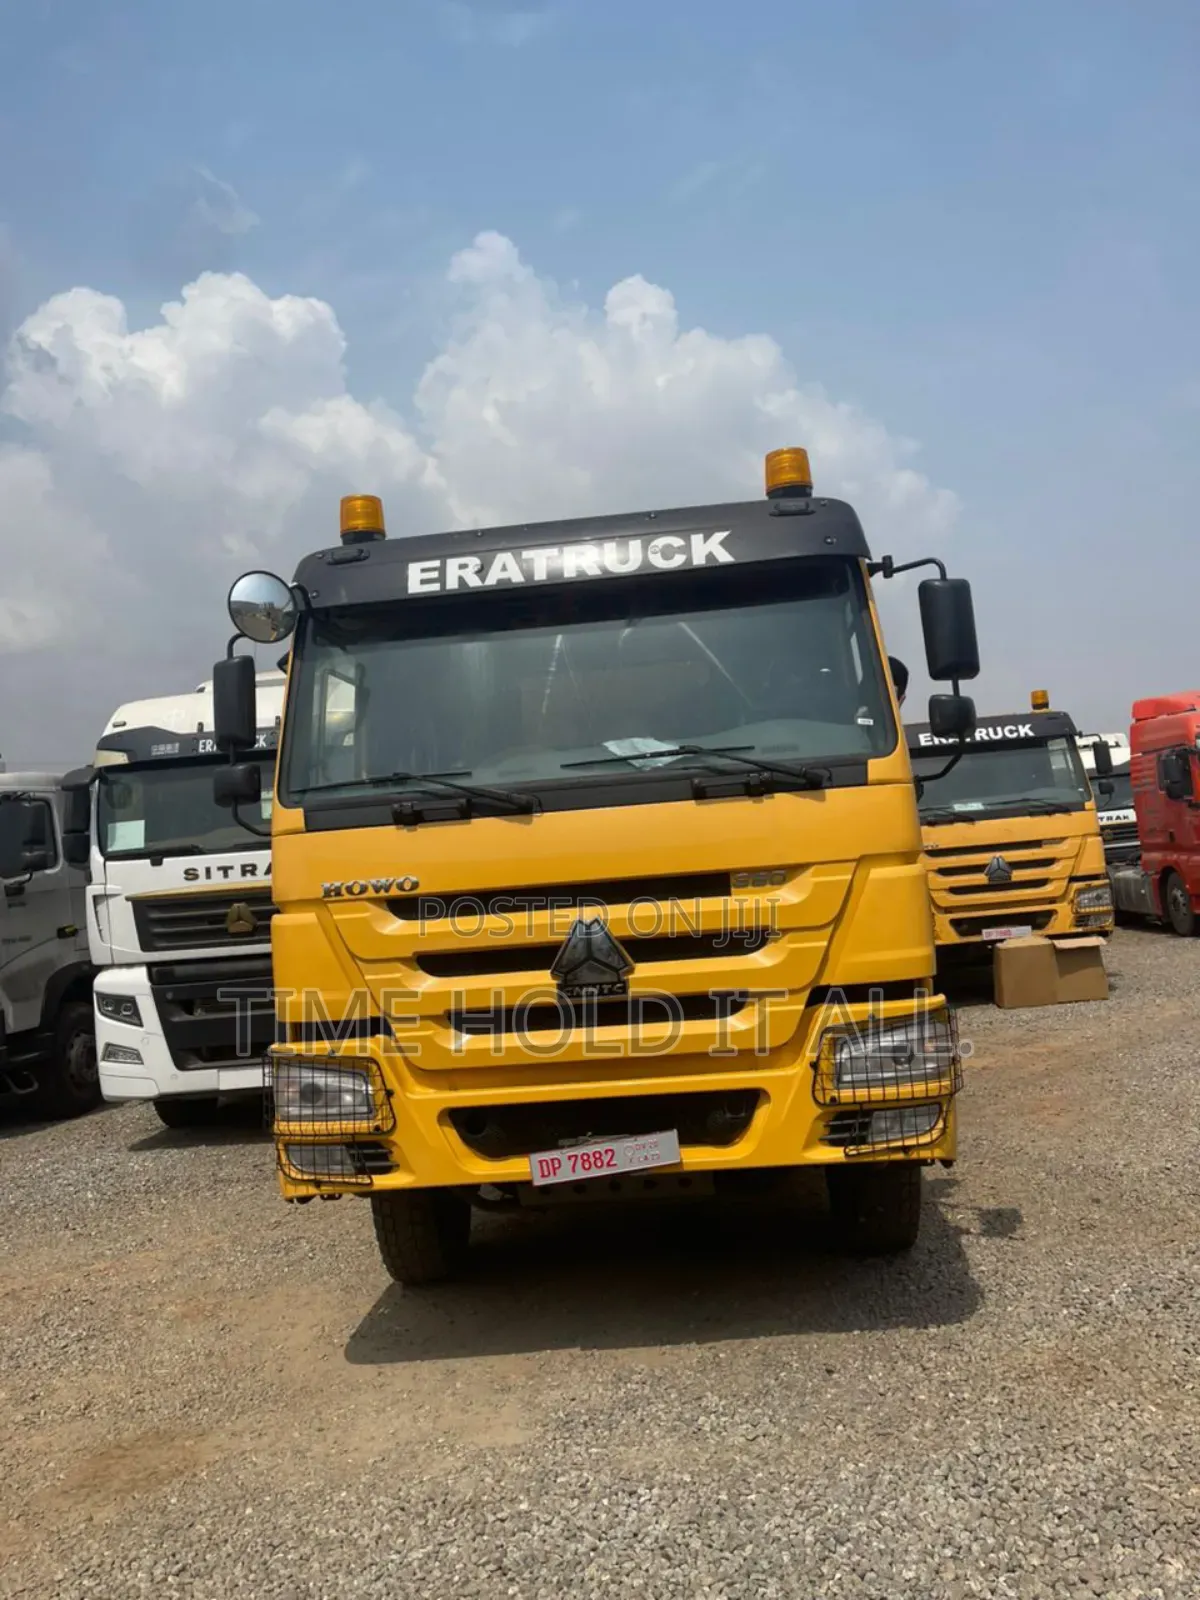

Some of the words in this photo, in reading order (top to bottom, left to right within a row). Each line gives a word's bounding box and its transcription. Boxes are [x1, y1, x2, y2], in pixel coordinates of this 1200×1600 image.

[407, 530, 735, 594] ERATRUCK
[918, 723, 1035, 746] ERUCK
[321, 876, 420, 898] HOWO
[538, 1158, 562, 1178] DP
[567, 1148, 617, 1174] 7882
